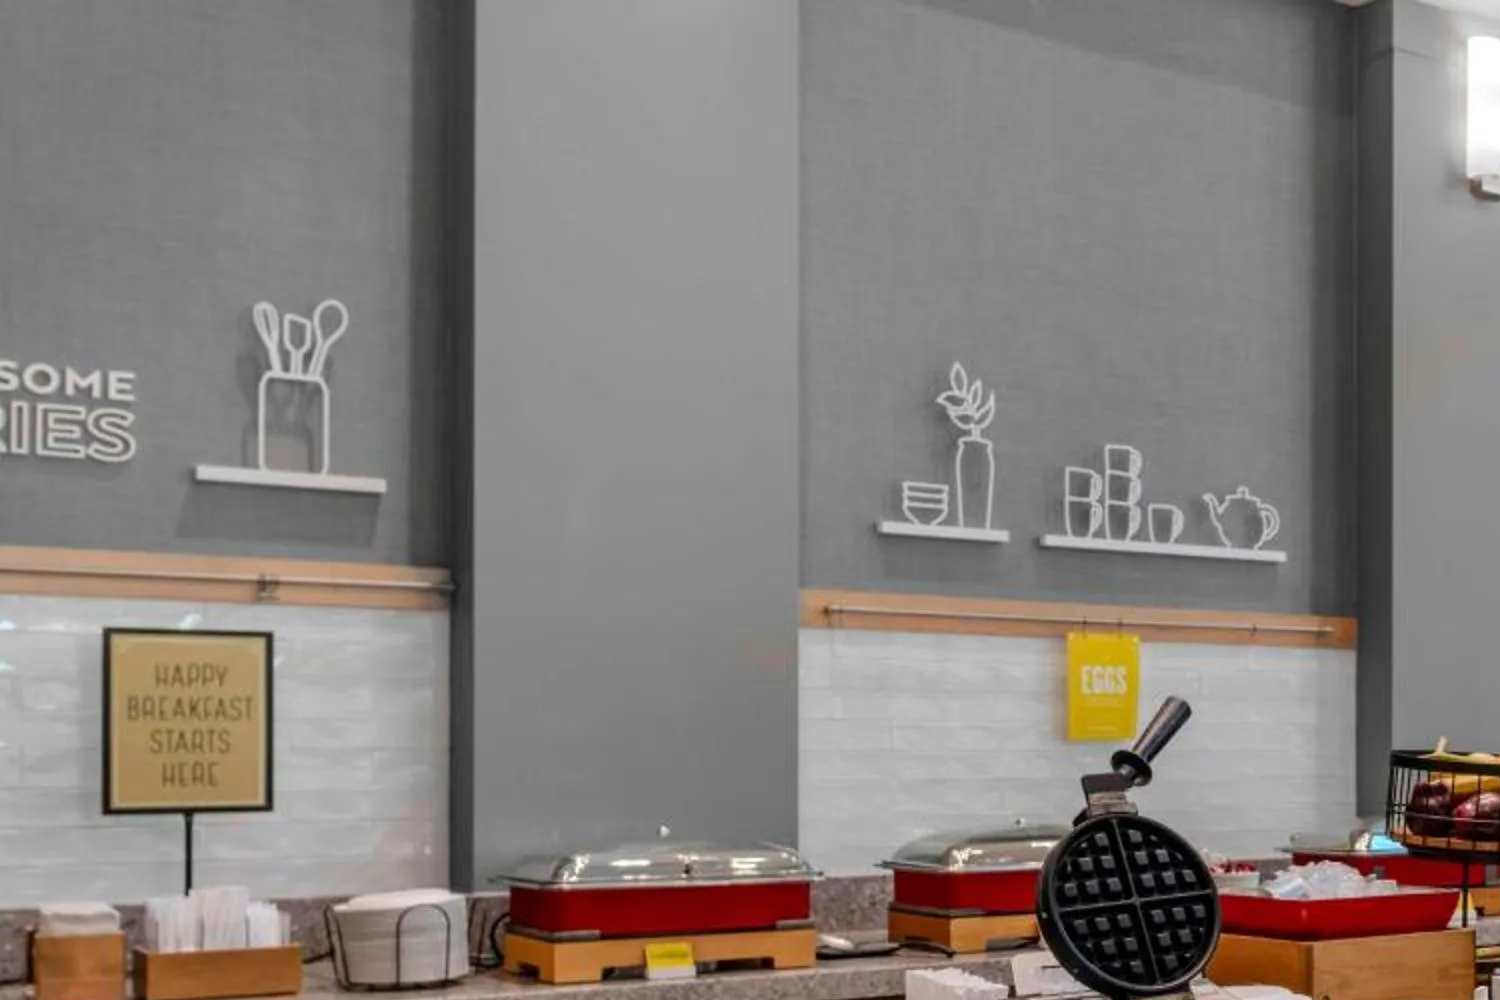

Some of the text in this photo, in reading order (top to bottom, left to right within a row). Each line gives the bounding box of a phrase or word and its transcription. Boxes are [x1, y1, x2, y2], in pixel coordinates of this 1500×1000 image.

[0, 400, 137, 461] IES
[155, 662, 229, 688] HAPPY
[1081, 664, 1128, 695] EGGS
[127, 695, 254, 722] BREAKFAST
[149, 728, 232, 755] STARTS
[161, 761, 220, 788] HERE
